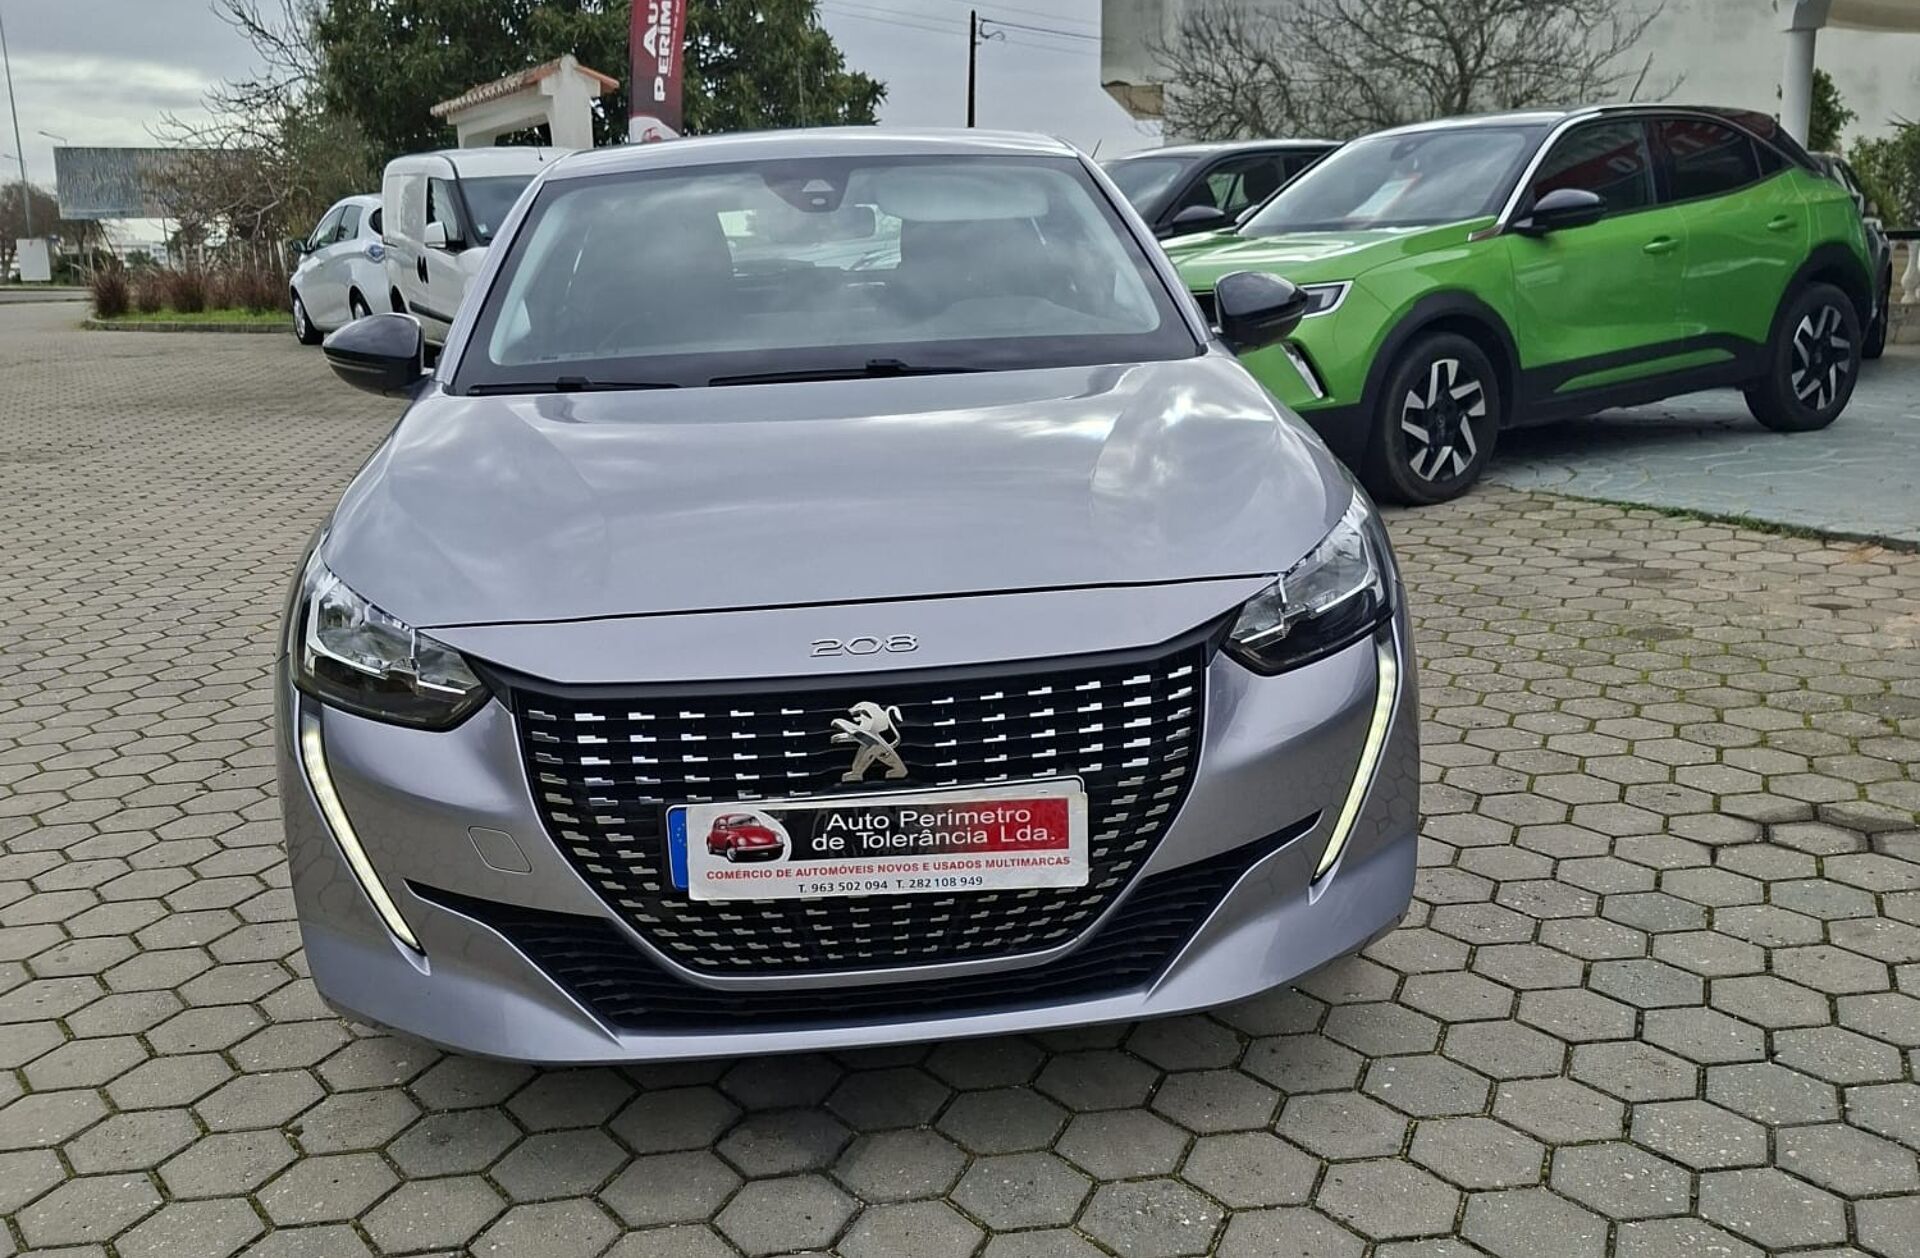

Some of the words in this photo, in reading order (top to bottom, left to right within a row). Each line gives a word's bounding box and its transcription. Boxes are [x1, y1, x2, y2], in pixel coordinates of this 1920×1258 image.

[643, 0, 659, 58] AU
[810, 634, 919, 657] 208
[826, 812, 890, 831] Auto
[900, 806, 1031, 828] Perímetro
[811, 833, 845, 851] de
[855, 827, 988, 849] Tolerância
[1000, 824, 1056, 842] Lda.
[776, 868, 792, 878] DE
[795, 863, 874, 877] AUTOMÓVEIS
[878, 862, 919, 873] NOVOS
[922, 862, 930, 872] E
[933, 859, 982, 871] USADOS
[985, 856, 1071, 869] MULTIMARCAS
[798, 883, 807, 893] T.
[811, 882, 834, 893] 963
[838, 880, 861, 891] 502
[865, 880, 888, 890] 094
[895, 879, 905, 889] T.
[909, 878, 931, 888] 282
[935, 877, 957, 888] 108
[960, 876, 983, 886] 949
